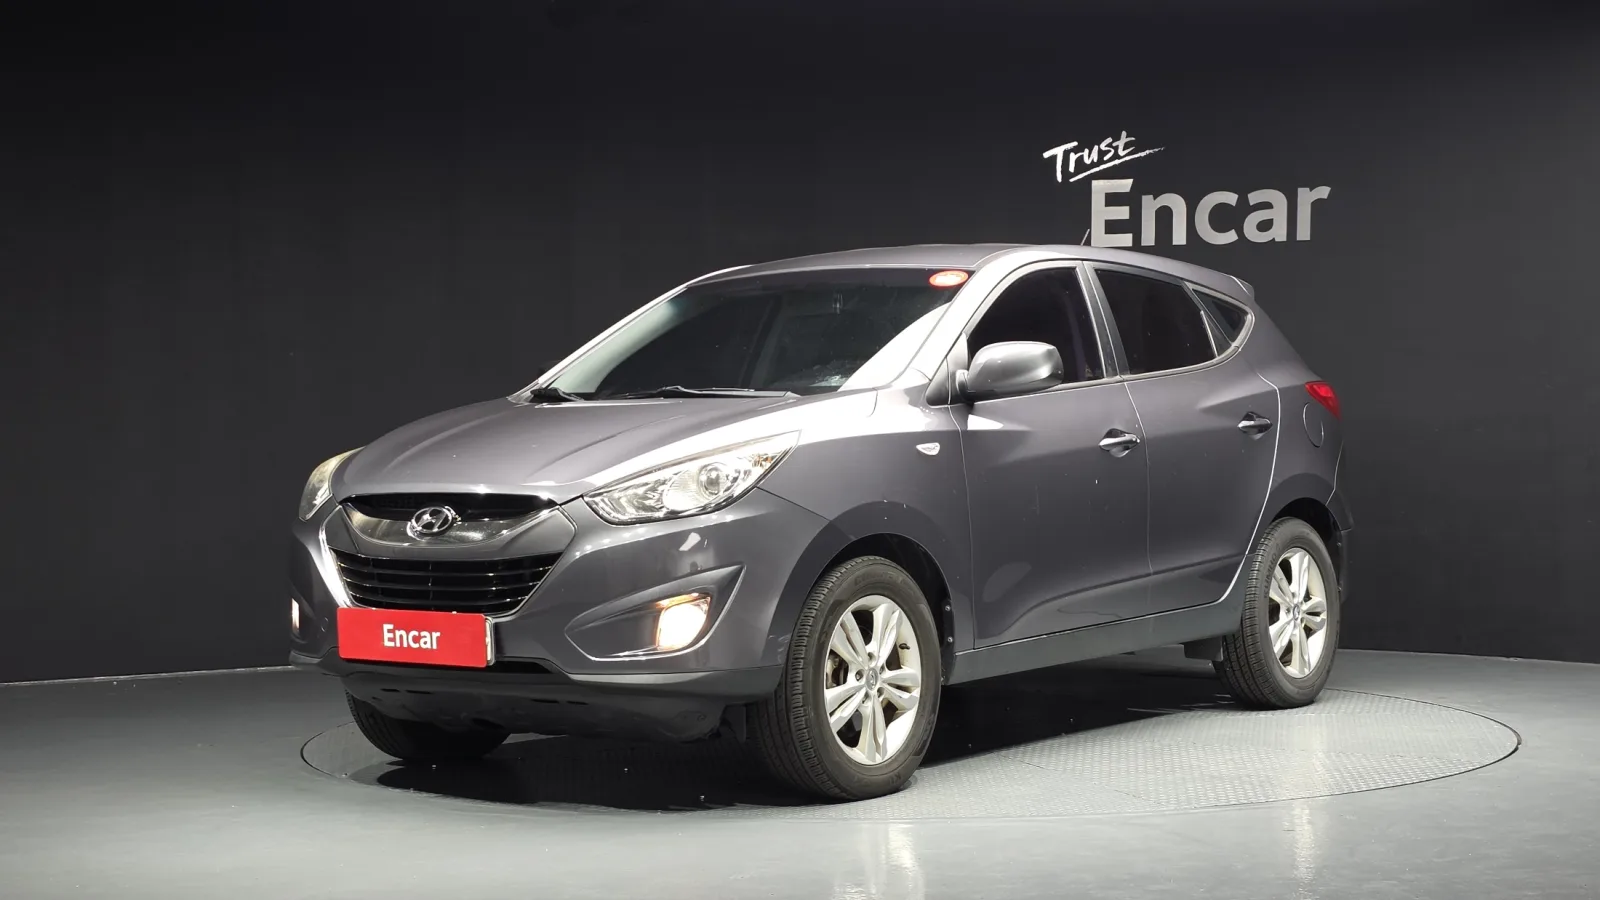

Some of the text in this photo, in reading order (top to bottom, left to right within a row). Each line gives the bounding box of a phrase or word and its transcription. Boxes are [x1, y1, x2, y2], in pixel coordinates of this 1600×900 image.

[1043, 131, 1136, 183] Trust
[1091, 178, 1331, 247] Encar
[382, 623, 441, 650] Encar
